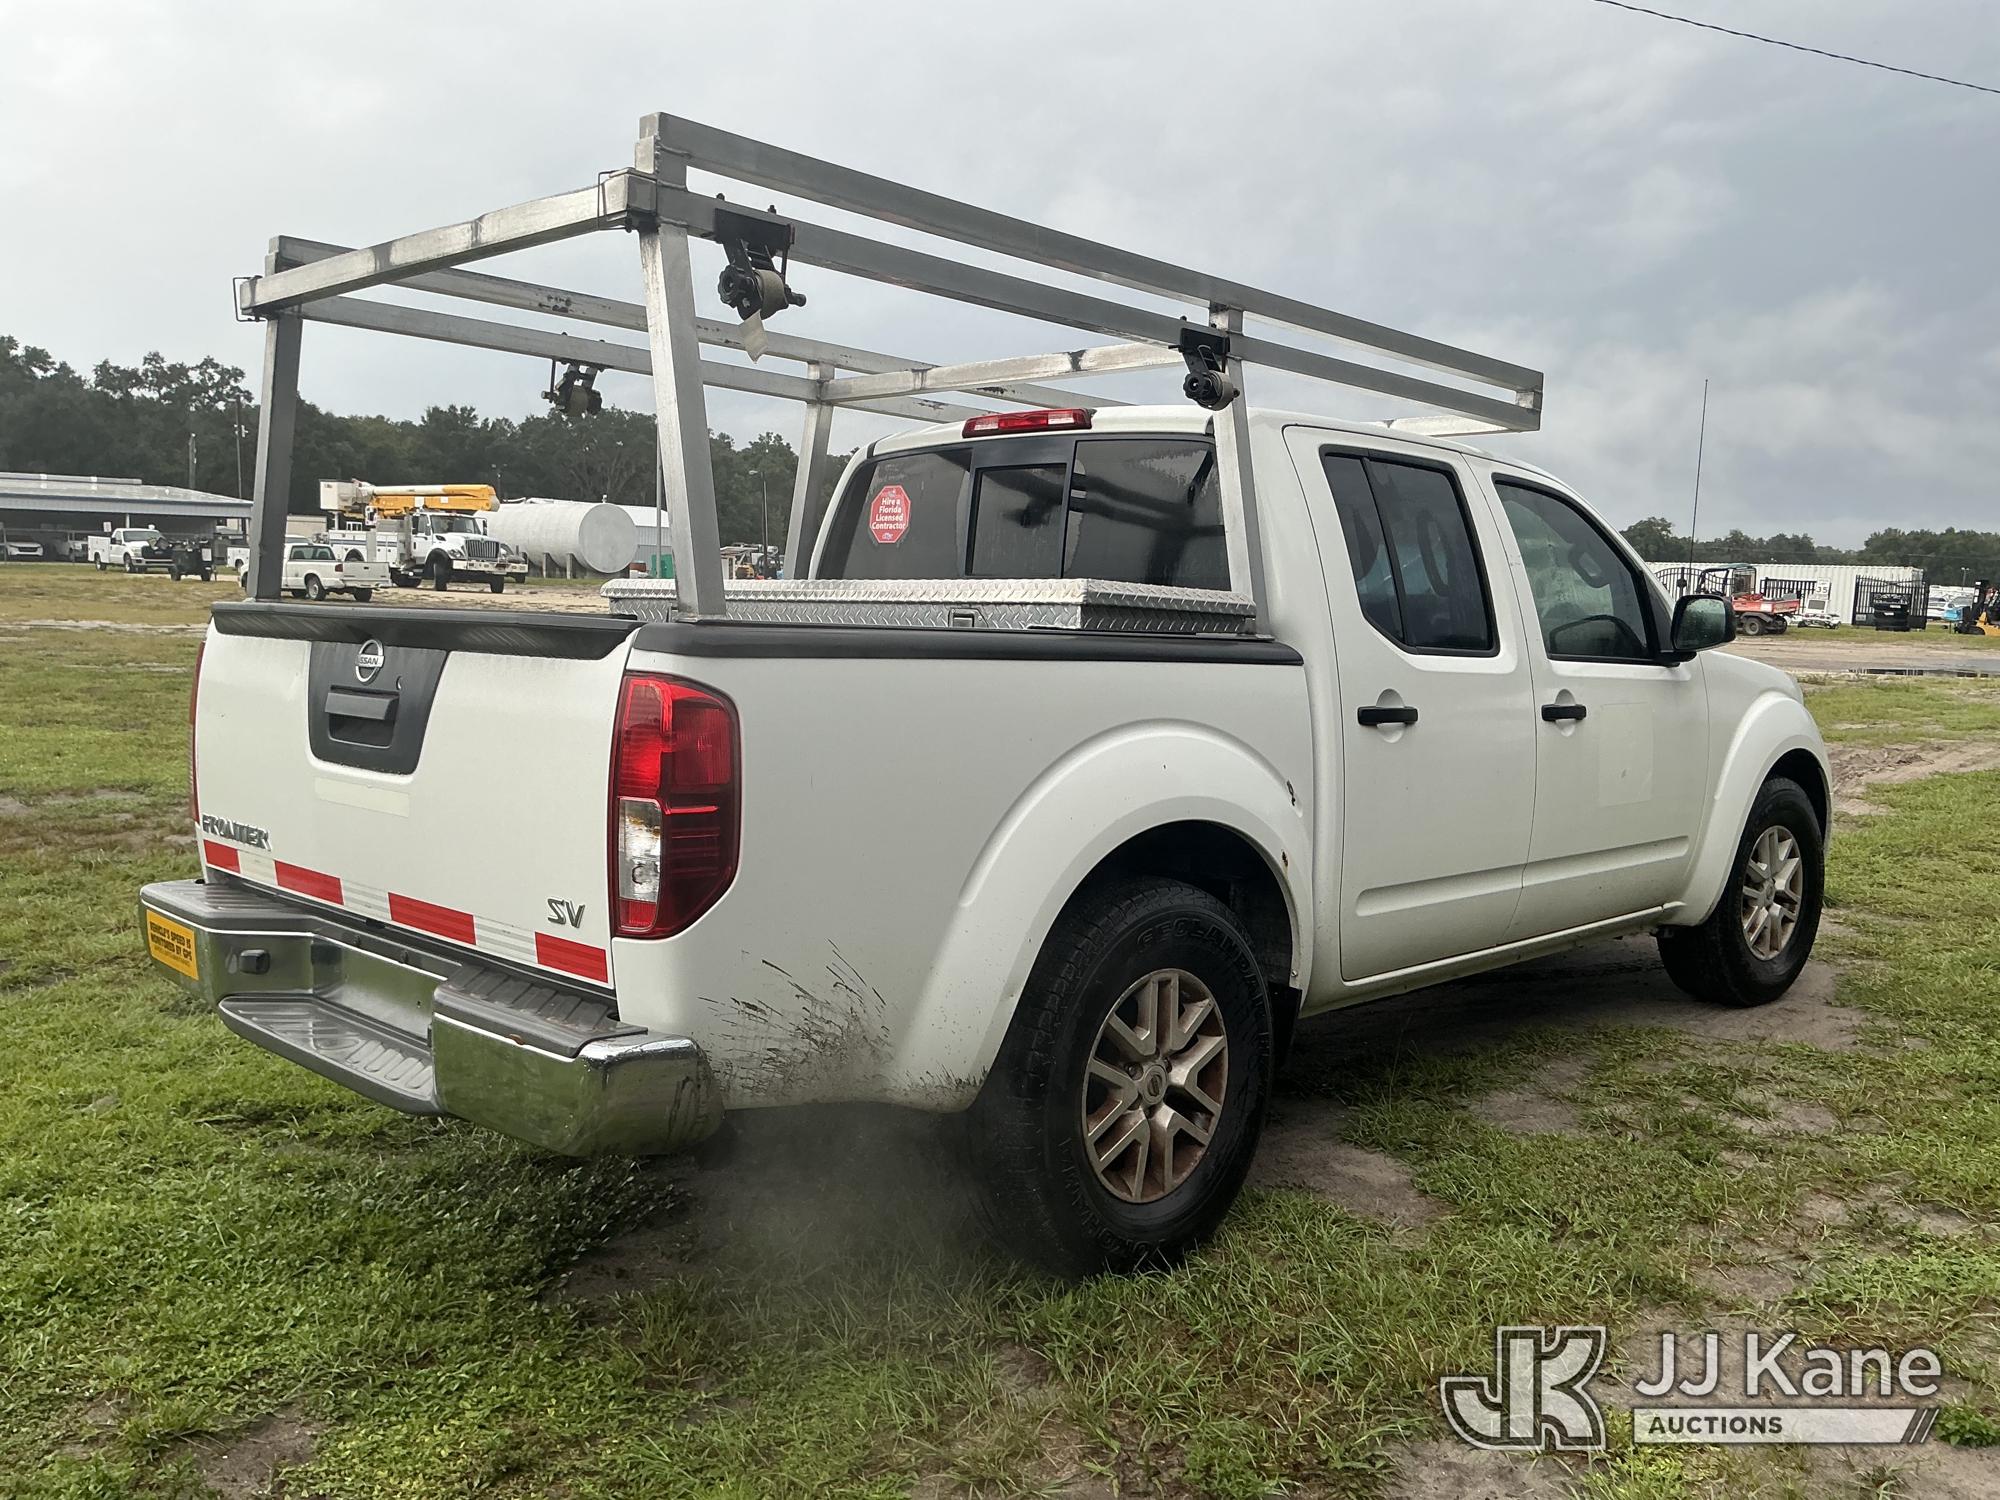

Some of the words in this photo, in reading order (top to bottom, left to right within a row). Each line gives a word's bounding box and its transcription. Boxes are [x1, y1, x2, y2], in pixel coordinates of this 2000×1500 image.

[882, 497, 895, 505] Hire
[879, 505, 902, 513] Florida
[875, 513, 904, 522] Licensed
[871, 521, 906, 530] Contractor
[1816, 586, 1828, 594] 35
[547, 898, 586, 929] SV
